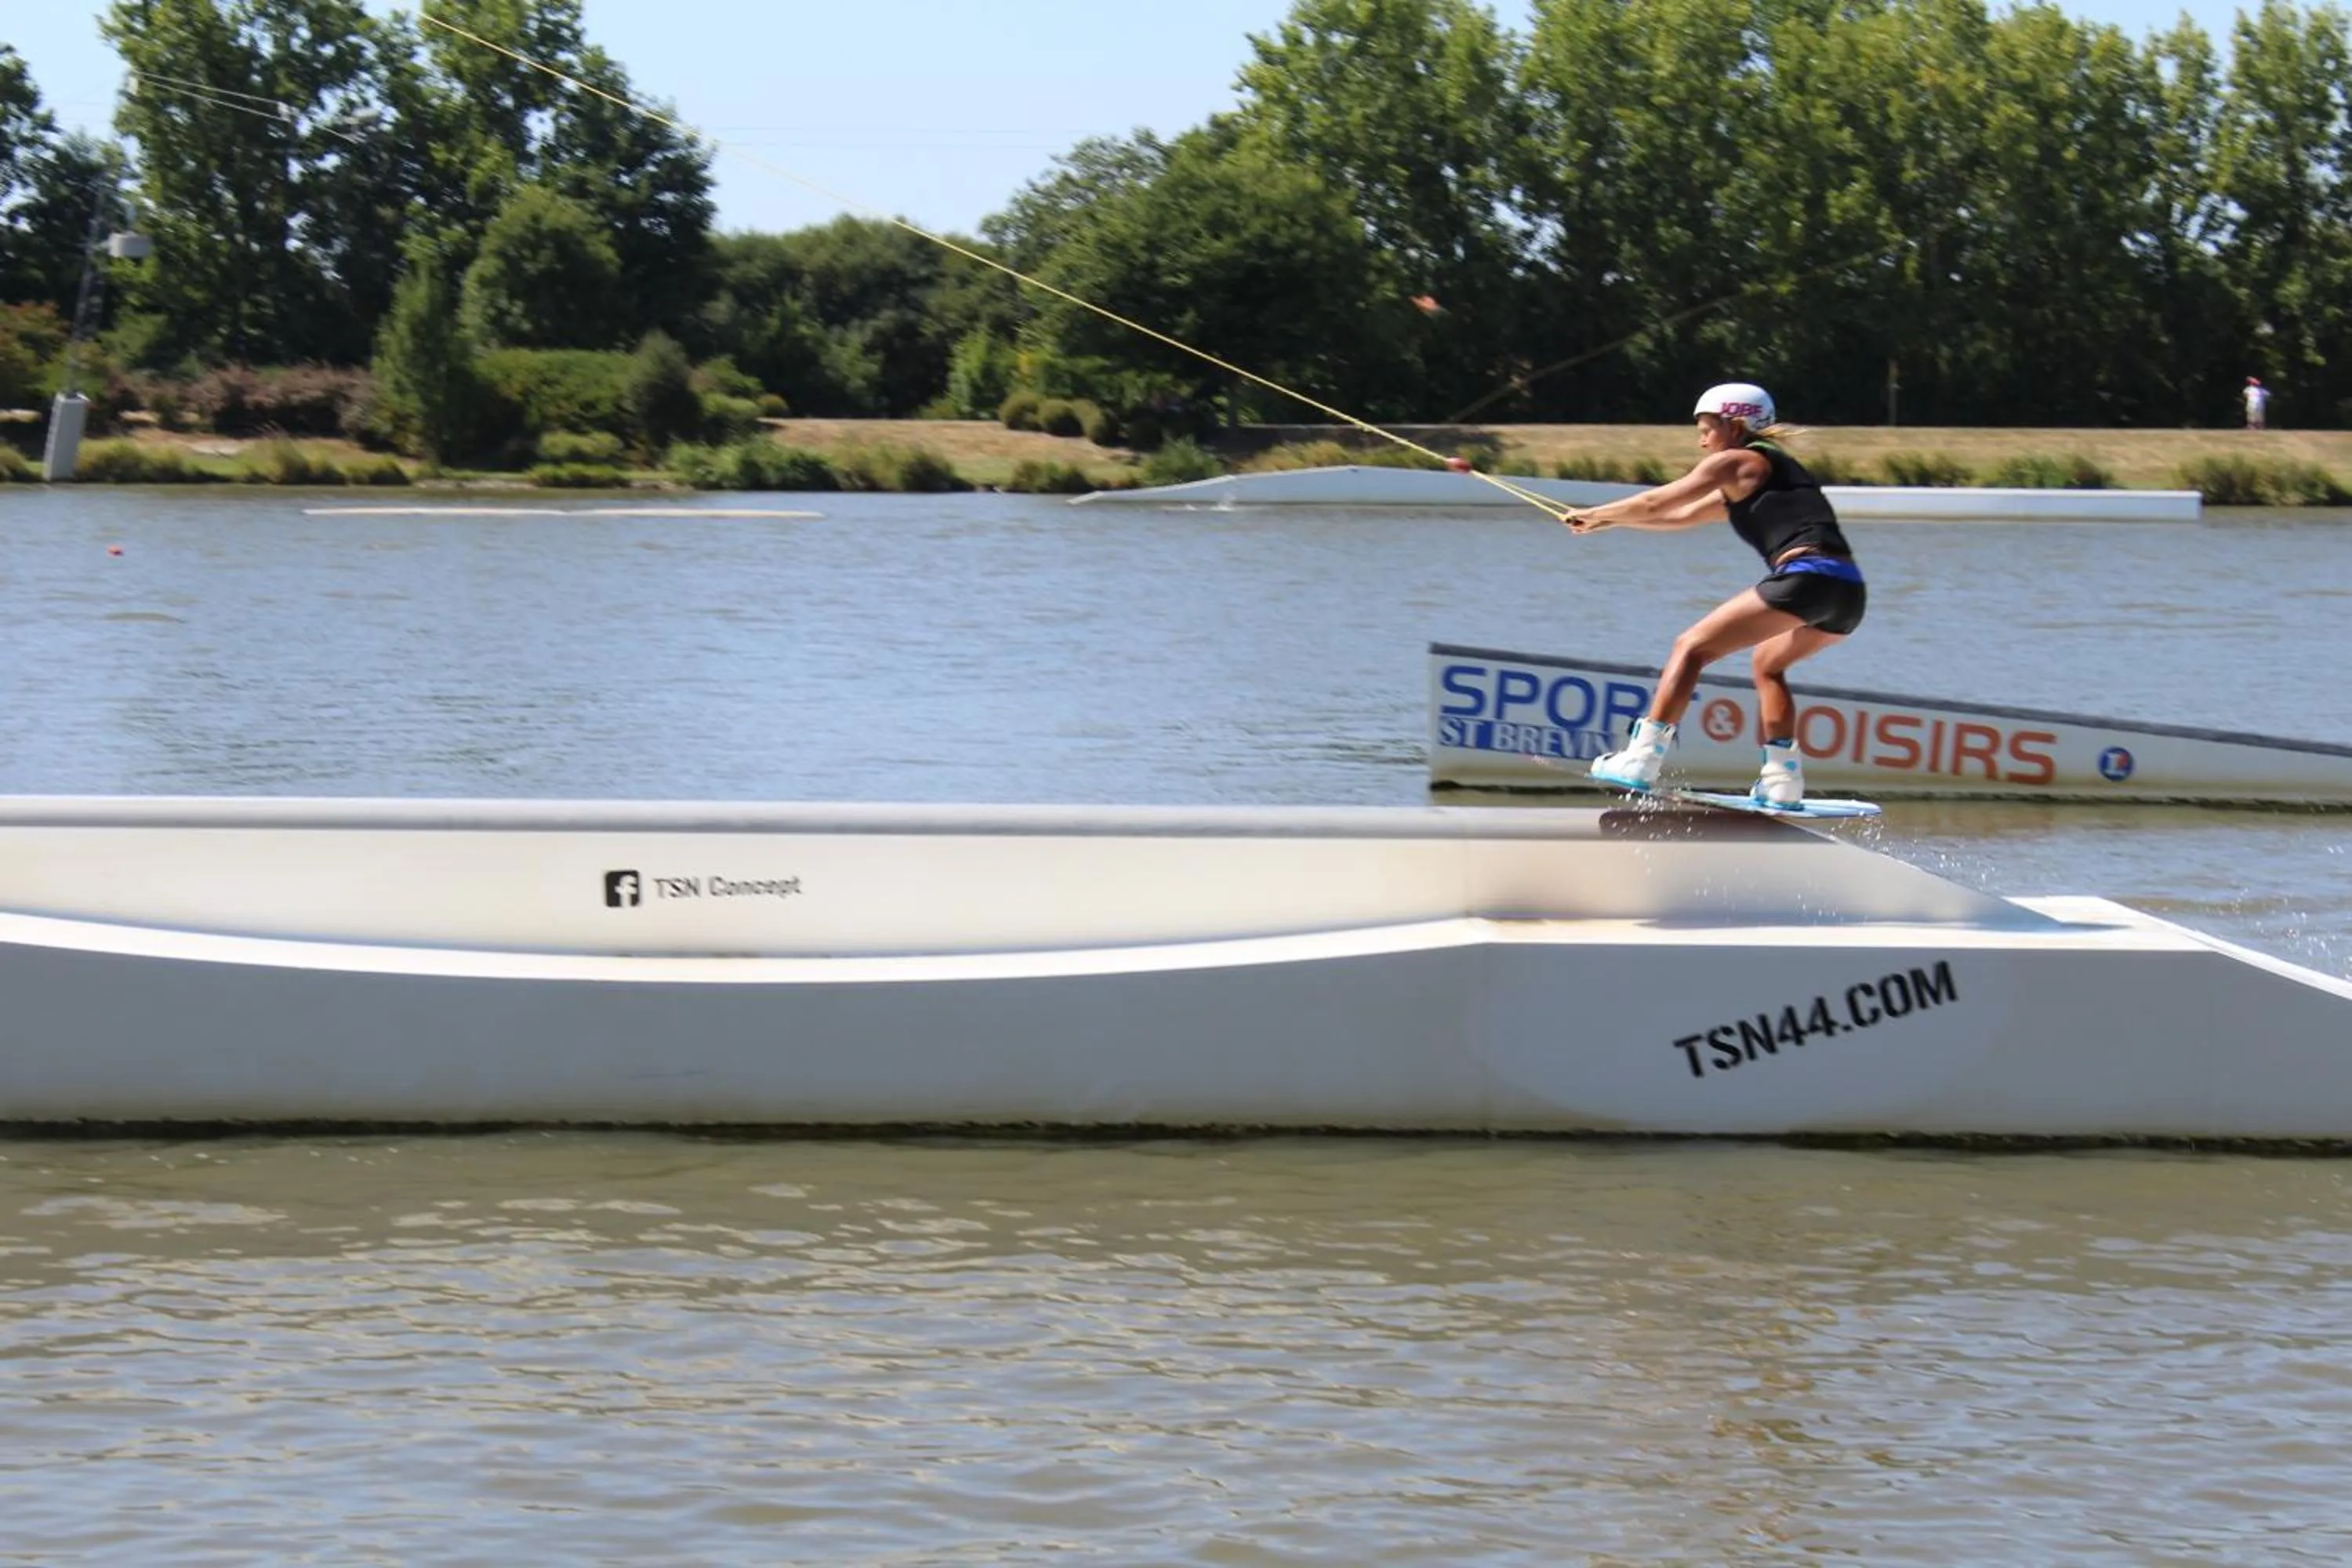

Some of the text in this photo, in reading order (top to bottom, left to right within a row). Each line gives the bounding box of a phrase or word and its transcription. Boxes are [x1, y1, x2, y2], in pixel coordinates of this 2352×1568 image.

[1721, 402, 1763, 416] JOBE
[1439, 663, 1700, 741] SPOR
[1705, 701, 1740, 739] &
[1440, 717, 1484, 747] ST
[652, 877, 701, 898] TSN
[709, 875, 802, 899] Concept
[1672, 960, 1958, 1079] TSN44.COM
